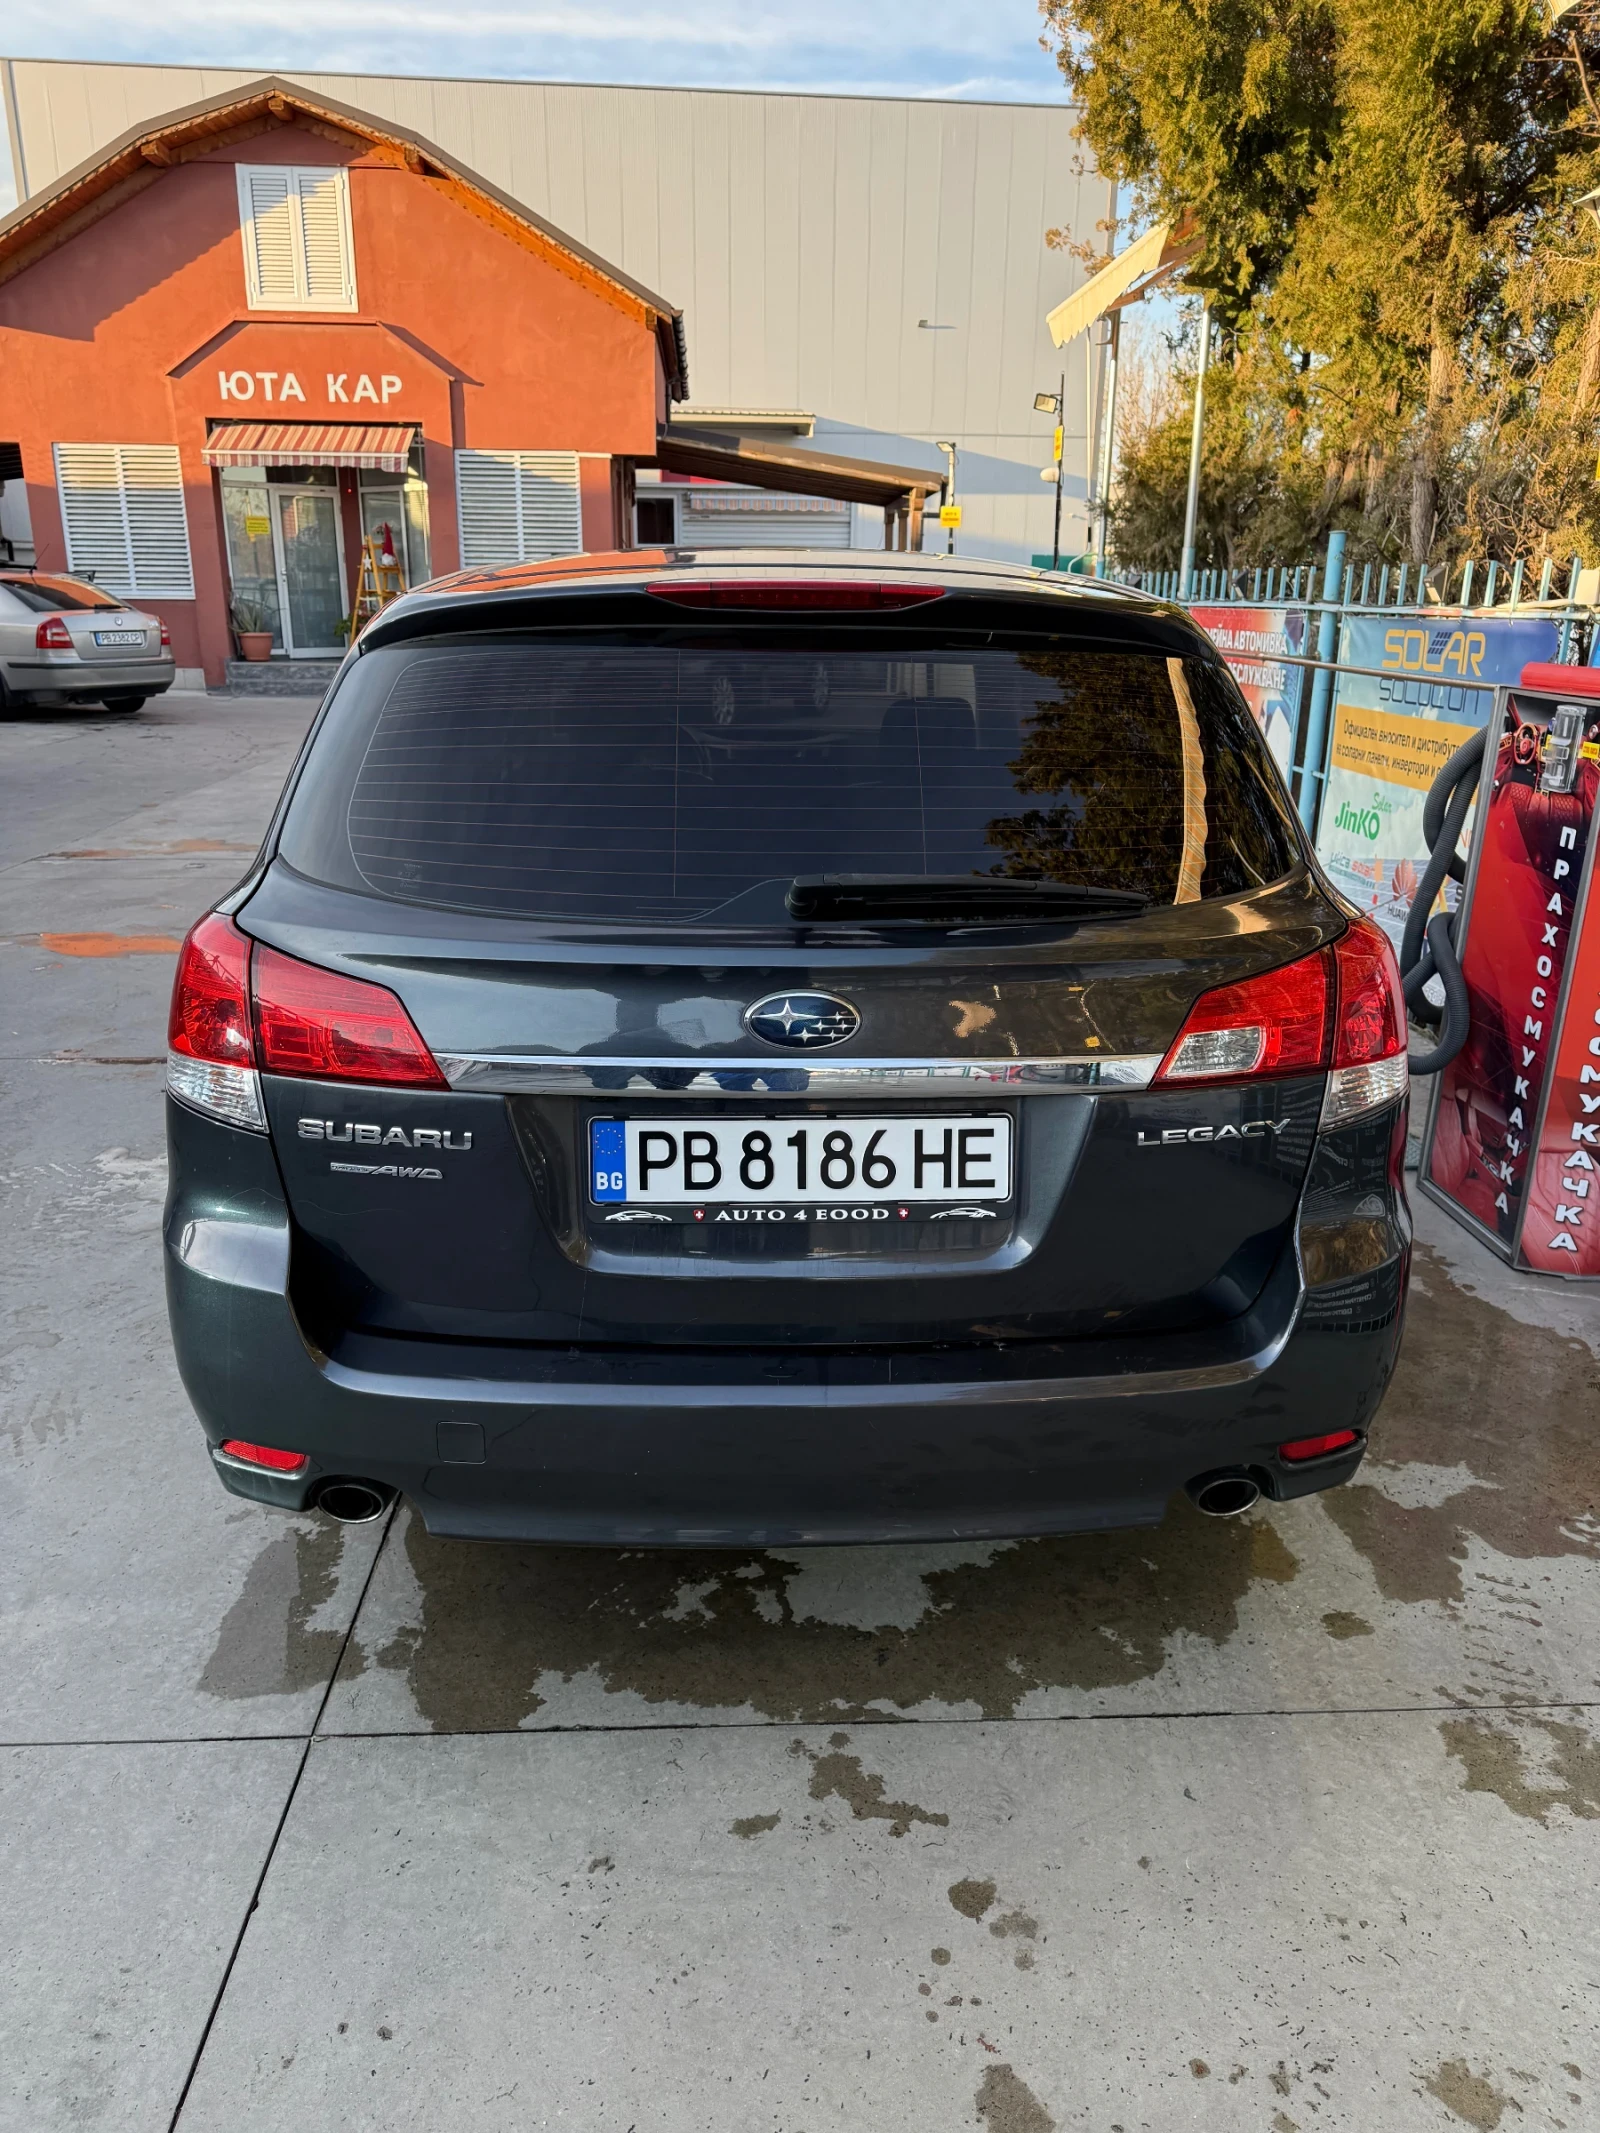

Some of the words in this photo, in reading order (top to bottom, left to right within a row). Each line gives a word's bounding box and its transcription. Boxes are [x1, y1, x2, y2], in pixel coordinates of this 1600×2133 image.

[218, 371, 306, 402] ЮТА
[326, 373, 402, 404] КАР
[1233, 630, 1288, 655] АВТОМИВКА
[1382, 628, 1486, 677] SOLAR
[1343, 719, 1378, 739] Официален
[1378, 730, 1411, 747] вносител
[1412, 737, 1417, 748] и
[1416, 737, 1460, 761] дистрибут
[1391, 757, 1430, 777] инвертори
[1495, 826, 1577, 1216] ПРАХОСМУКАЧКА
[297, 1118, 473, 1151] SUBARU
[1137, 1118, 1291, 1147] LEGACY
[371, 1164, 443, 1180] AWD
[639, 1130, 722, 1191] PB
[739, 1129, 897, 1190] 8186
[914, 1128, 996, 1189] HE
[596, 1171, 623, 1190] BG
[714, 1209, 786, 1221] AUTO
[793, 1209, 808, 1221] 4
[815, 1208, 890, 1221] EOOD
